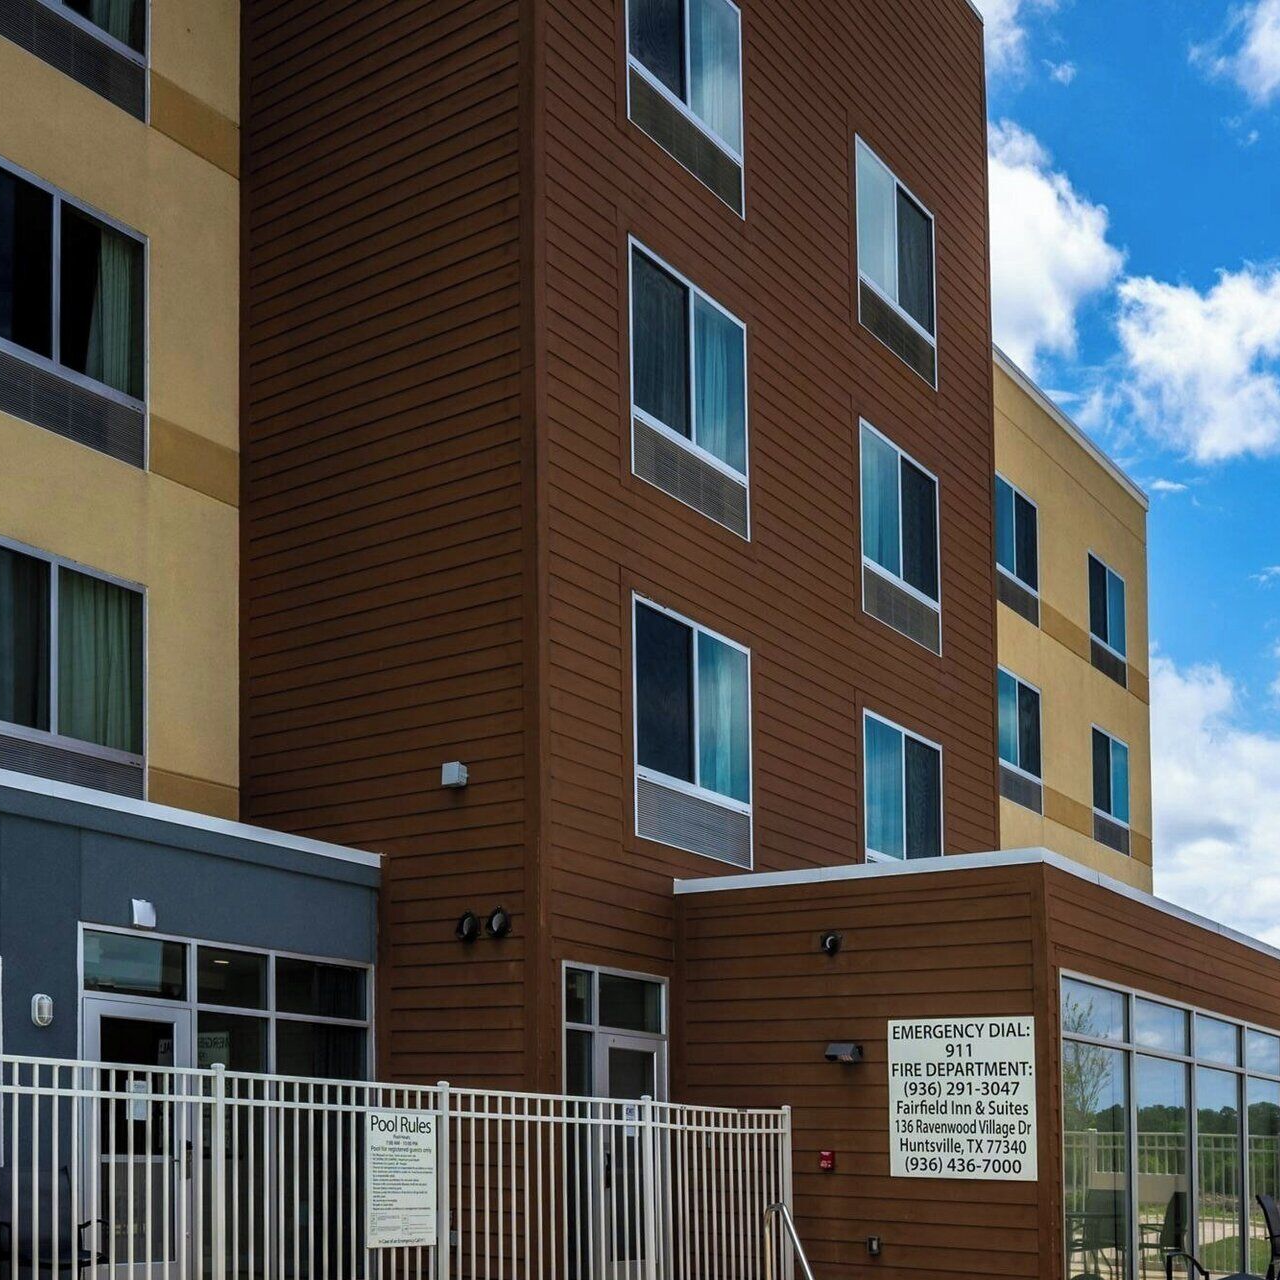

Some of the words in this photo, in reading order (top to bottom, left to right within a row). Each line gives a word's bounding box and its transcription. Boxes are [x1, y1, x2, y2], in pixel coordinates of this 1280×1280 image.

[892, 1023, 985, 1039] EMERGENCY
[989, 1023, 1030, 1038] DIAL:
[945, 1043, 972, 1057] 911
[892, 1063, 921, 1077] FIRE
[926, 1062, 1032, 1077] DEPARTMENT:
[904, 1082, 942, 1097] (936)
[946, 1081, 1020, 1096] 291-3047
[896, 1100, 948, 1115] Fairfield
[951, 1101, 972, 1115] Inn
[975, 1101, 985, 1115] &
[988, 1101, 1029, 1115] Suites
[371, 1115, 398, 1132] Pool
[401, 1116, 432, 1134] Rules
[895, 1119, 914, 1134] 136
[916, 1119, 977, 1134] Ravenwood
[979, 1120, 1015, 1138] Village
[1018, 1120, 1032, 1135] Dr
[900, 1138, 964, 1155] Huntsville,
[967, 1139, 984, 1154] TX
[986, 1140, 1027, 1154] 77340
[905, 1157, 943, 1173] (936)
[947, 1158, 1022, 1174] 436-7000
